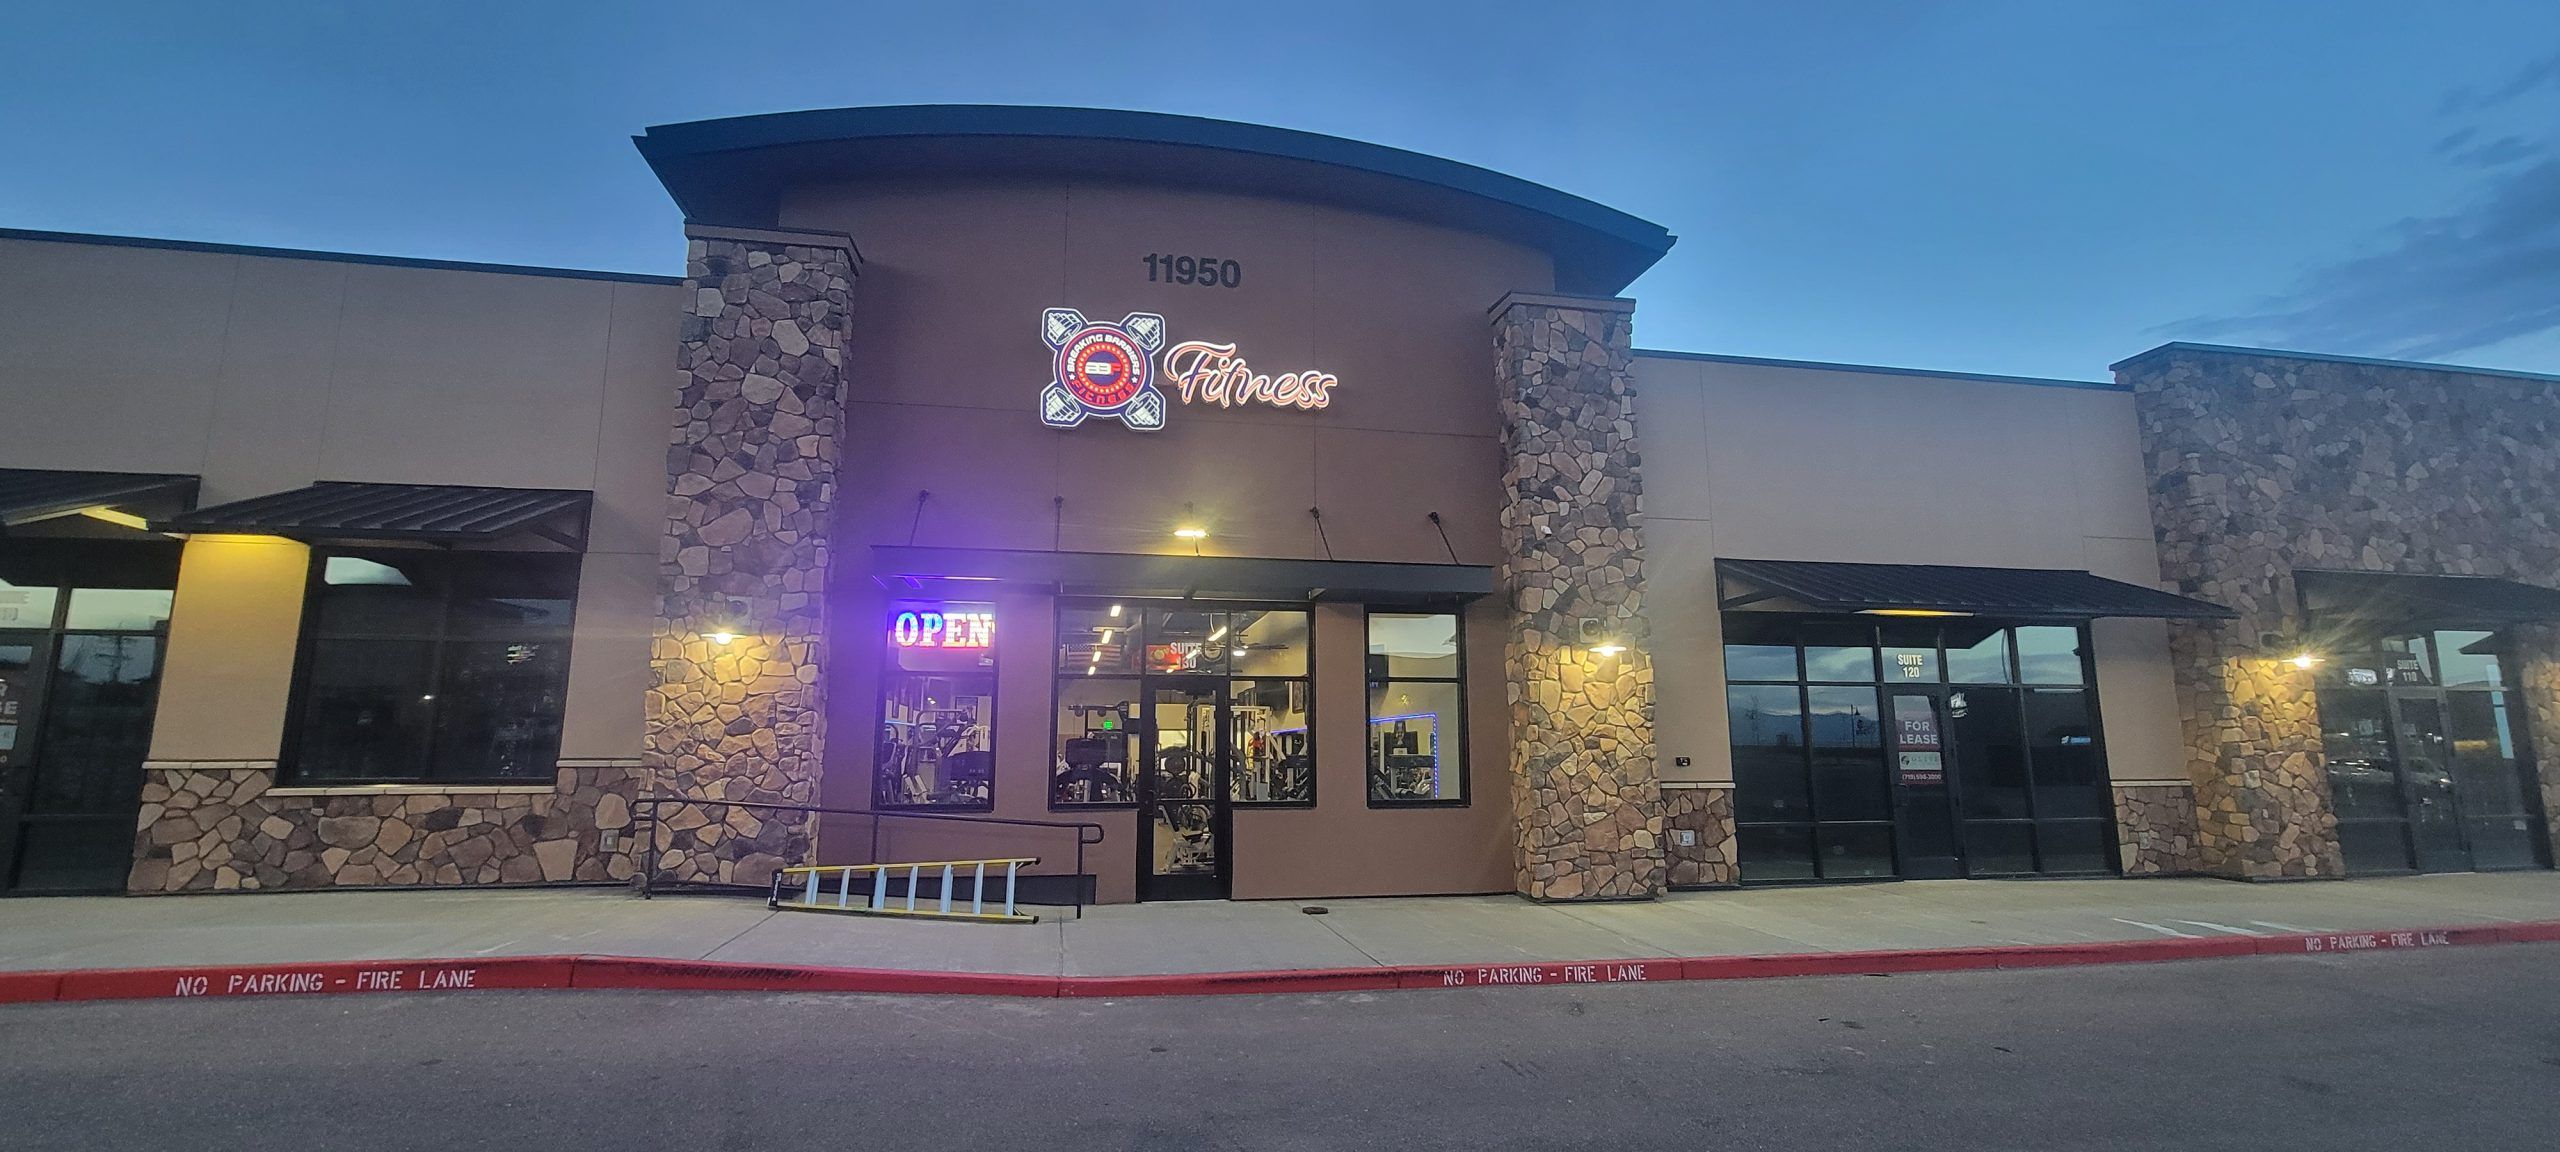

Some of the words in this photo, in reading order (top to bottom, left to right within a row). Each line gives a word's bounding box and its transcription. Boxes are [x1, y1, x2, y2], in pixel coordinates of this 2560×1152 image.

[1143, 253, 1242, 289] 11950
[1067, 334, 1103, 373] BREAKING
[1104, 334, 1141, 376] BARRIERS
[1163, 341, 1338, 409] Fitness
[895, 611, 993, 648] OPEN
[1170, 642, 1202, 655] SUITE
[1177, 657, 1197, 669] 130
[1897, 654, 1923, 666] SUITE
[2396, 659, 2420, 670] SUITE
[1903, 666, 1920, 678] 120
[2402, 671, 2418, 682] 110
[1905, 721, 1930, 732] FOR
[1900, 734, 1939, 745] LEASE
[2305, 937, 2322, 951] NO
[2329, 934, 2377, 950] PARKING
[2390, 932, 2415, 947] FIRE
[2421, 931, 2450, 946] LANE
[1444, 970, 1465, 986] NO
[1478, 967, 1542, 984] PARKING
[1564, 965, 1596, 983] FIRE
[1607, 964, 1646, 982] LANE
[175, 976, 208, 997] NO
[227, 973, 324, 994] PARKING
[356, 970, 403, 990] FIRE
[418, 969, 476, 989] LANE
